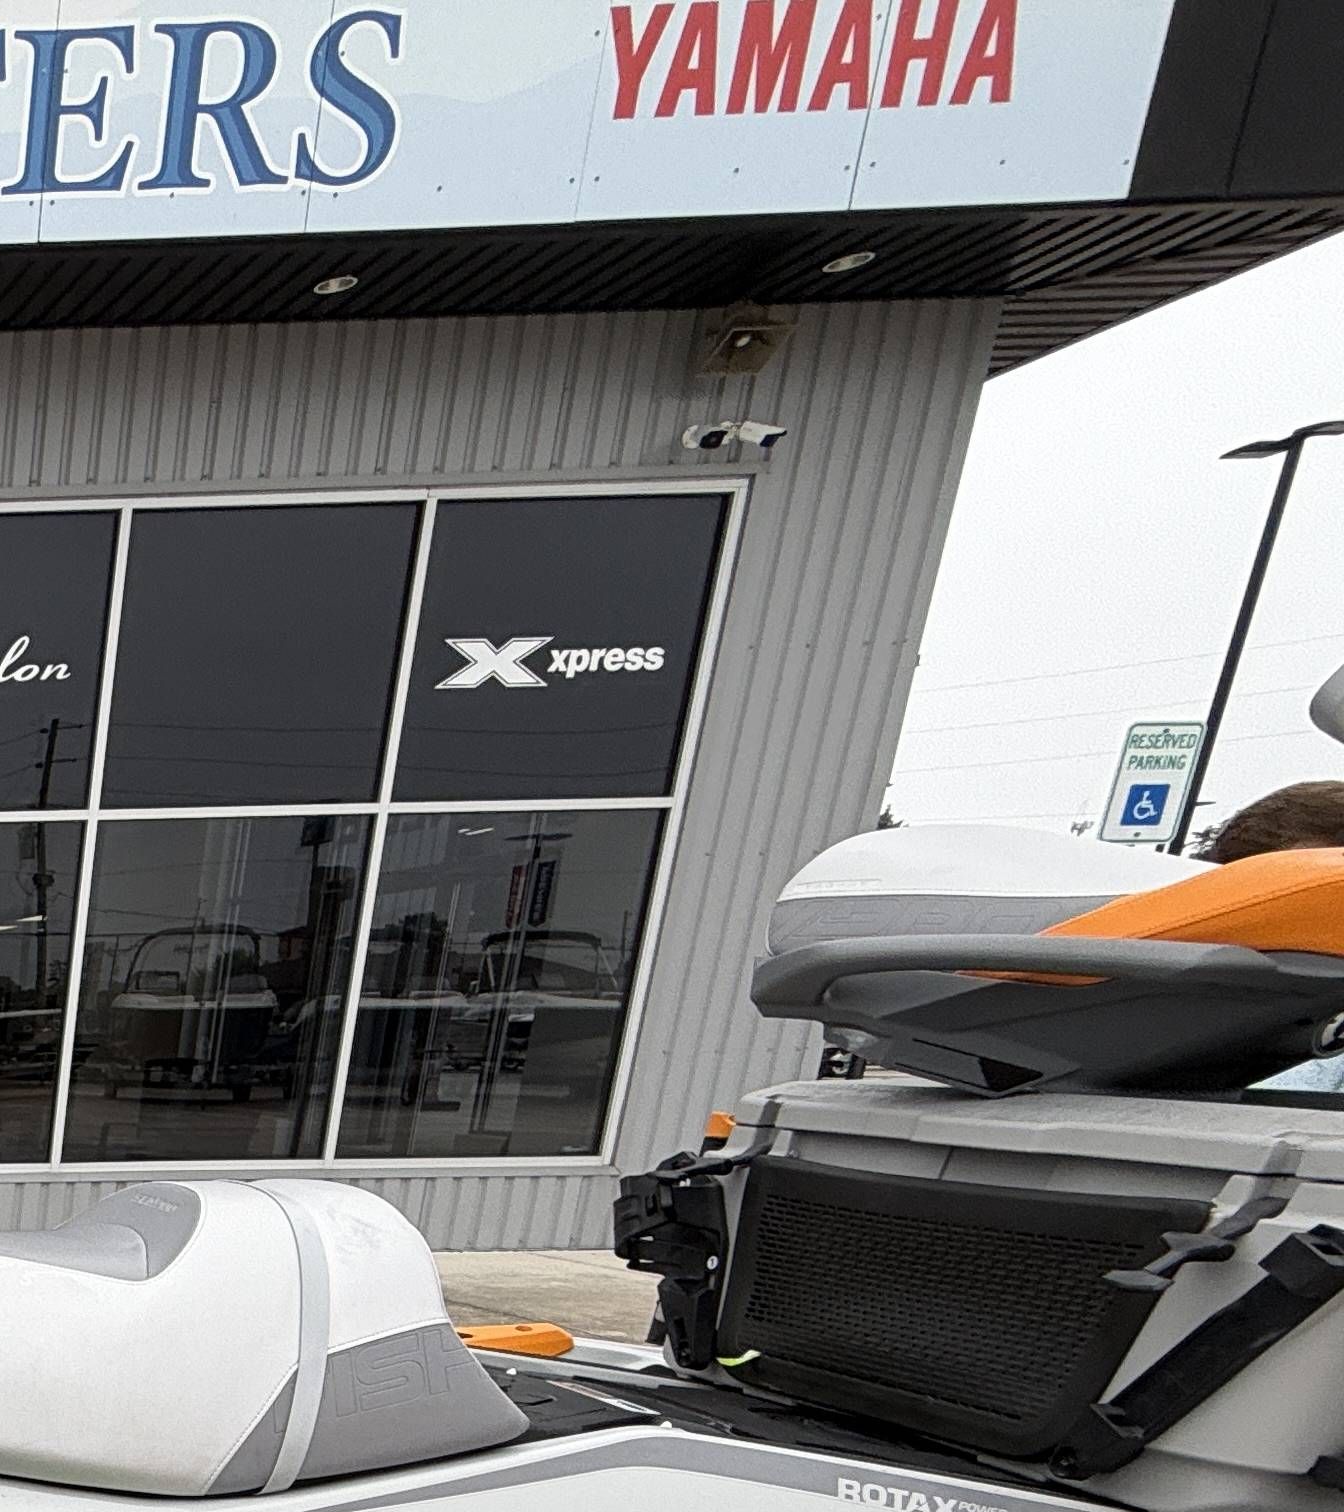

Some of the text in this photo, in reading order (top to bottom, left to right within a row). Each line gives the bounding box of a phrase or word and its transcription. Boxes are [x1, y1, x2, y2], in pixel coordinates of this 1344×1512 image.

[610, 0, 1018, 120] YAMAHA
[547, 646, 665, 679] xpress
[1128, 733, 1198, 750] RESERVED
[1126, 754, 1187, 770] PARKING
